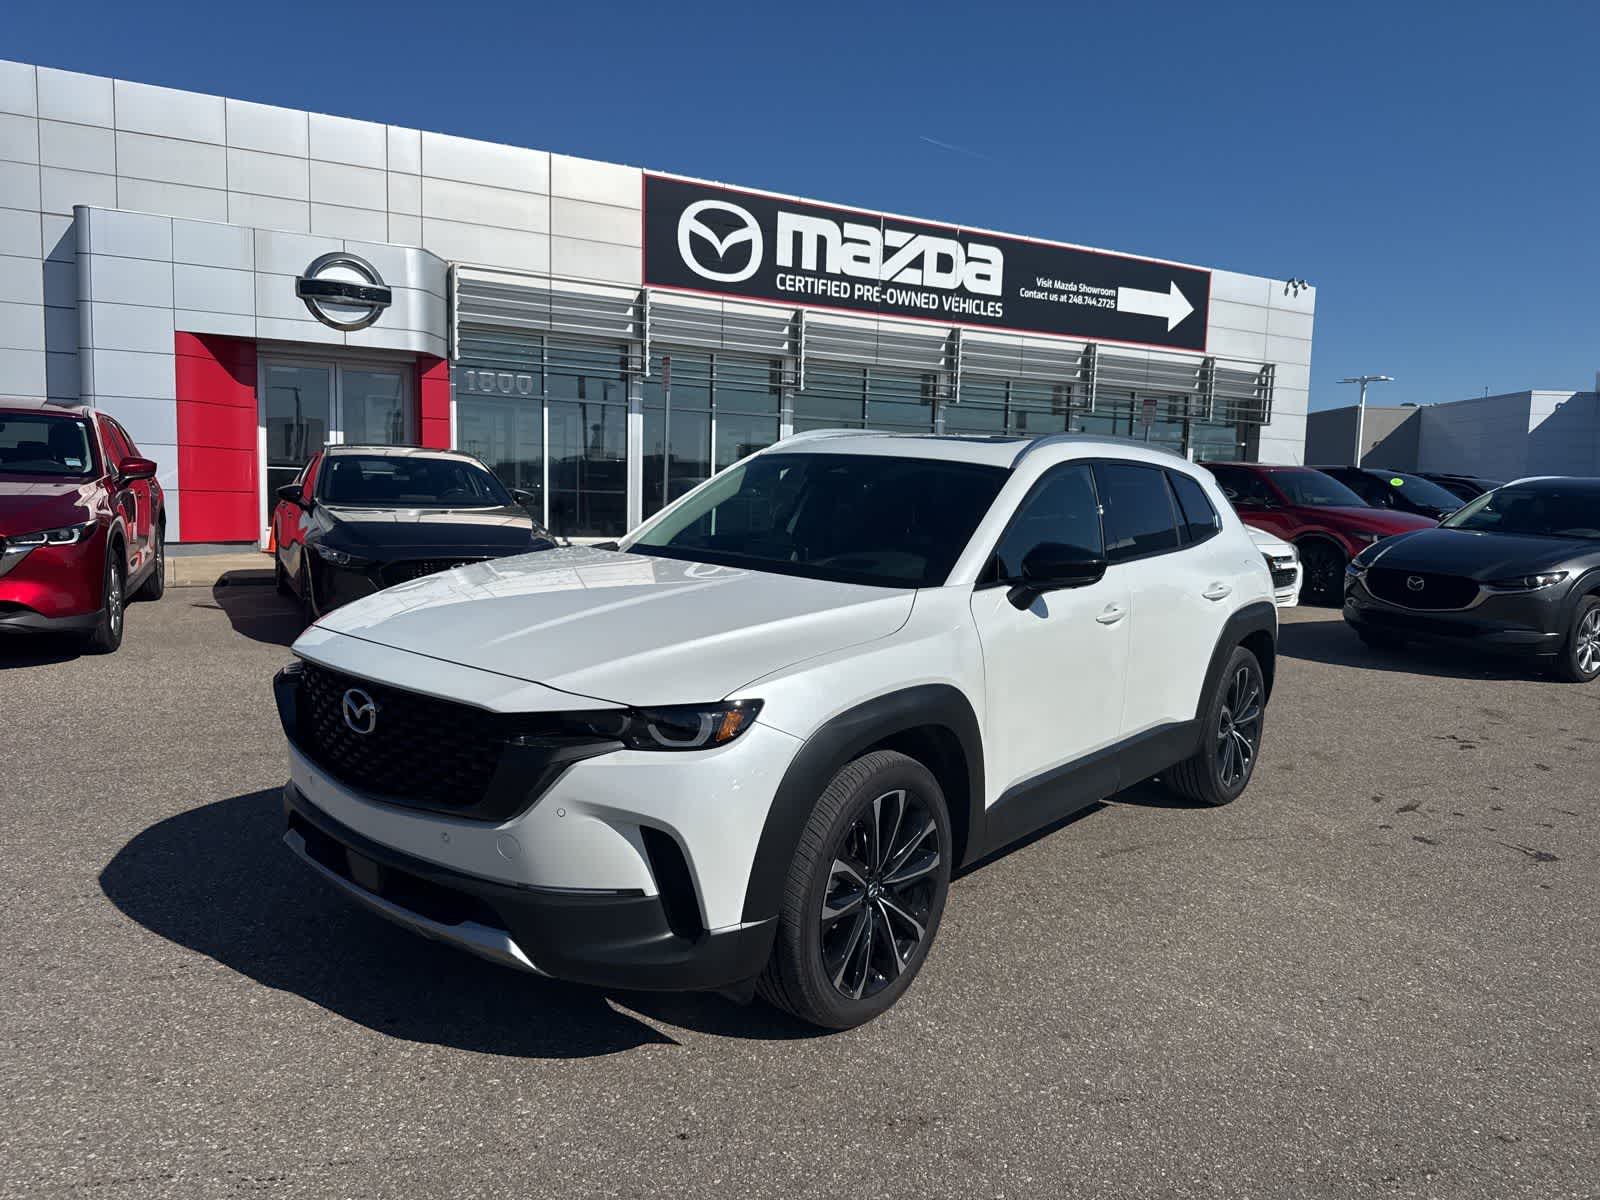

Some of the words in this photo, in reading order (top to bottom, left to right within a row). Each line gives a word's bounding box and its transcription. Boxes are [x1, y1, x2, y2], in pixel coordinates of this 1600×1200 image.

[776, 273, 851, 299] CERTIFIED
[854, 283, 938, 310] PRE-OWNED
[942, 295, 1003, 318] VEHICLES
[1036, 276, 1053, 289] Visit
[1053, 279, 1078, 292] Mazda
[1078, 283, 1116, 297] Showroom
[1019, 287, 1048, 300] Contact
[1049, 292, 1059, 302] us
[1059, 294, 1068, 303] at
[1068, 294, 1116, 309] 248.744.2725
